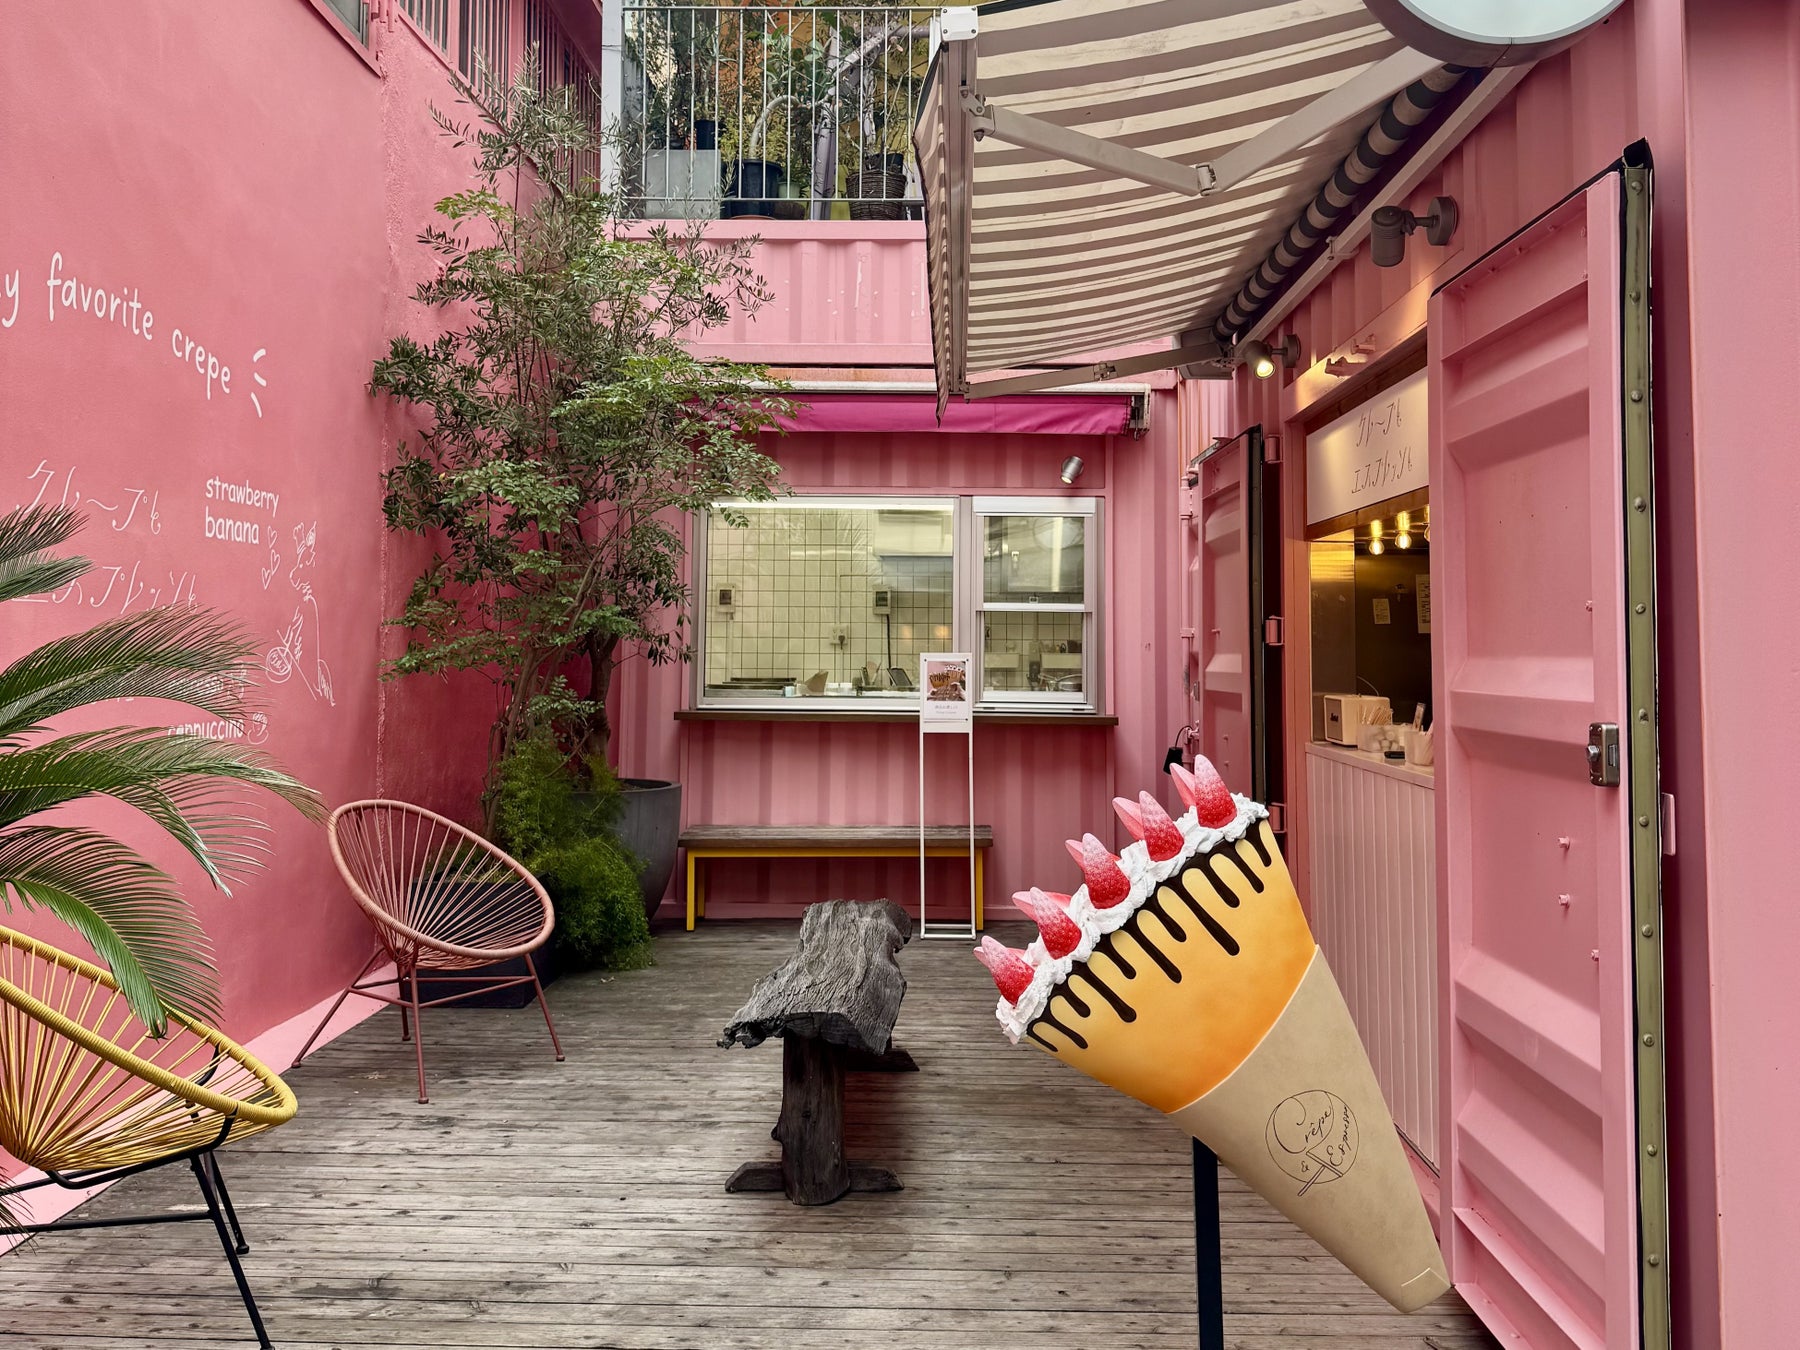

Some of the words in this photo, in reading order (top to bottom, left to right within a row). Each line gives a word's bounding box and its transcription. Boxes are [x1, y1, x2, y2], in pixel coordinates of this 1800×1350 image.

[0, 269, 20, 328] y
[47, 251, 153, 340] favorite
[172, 328, 231, 401] crepe
[205, 475, 279, 518] strawberry
[205, 505, 260, 544] banana
[1326, 1104, 1352, 1167] Espresso
